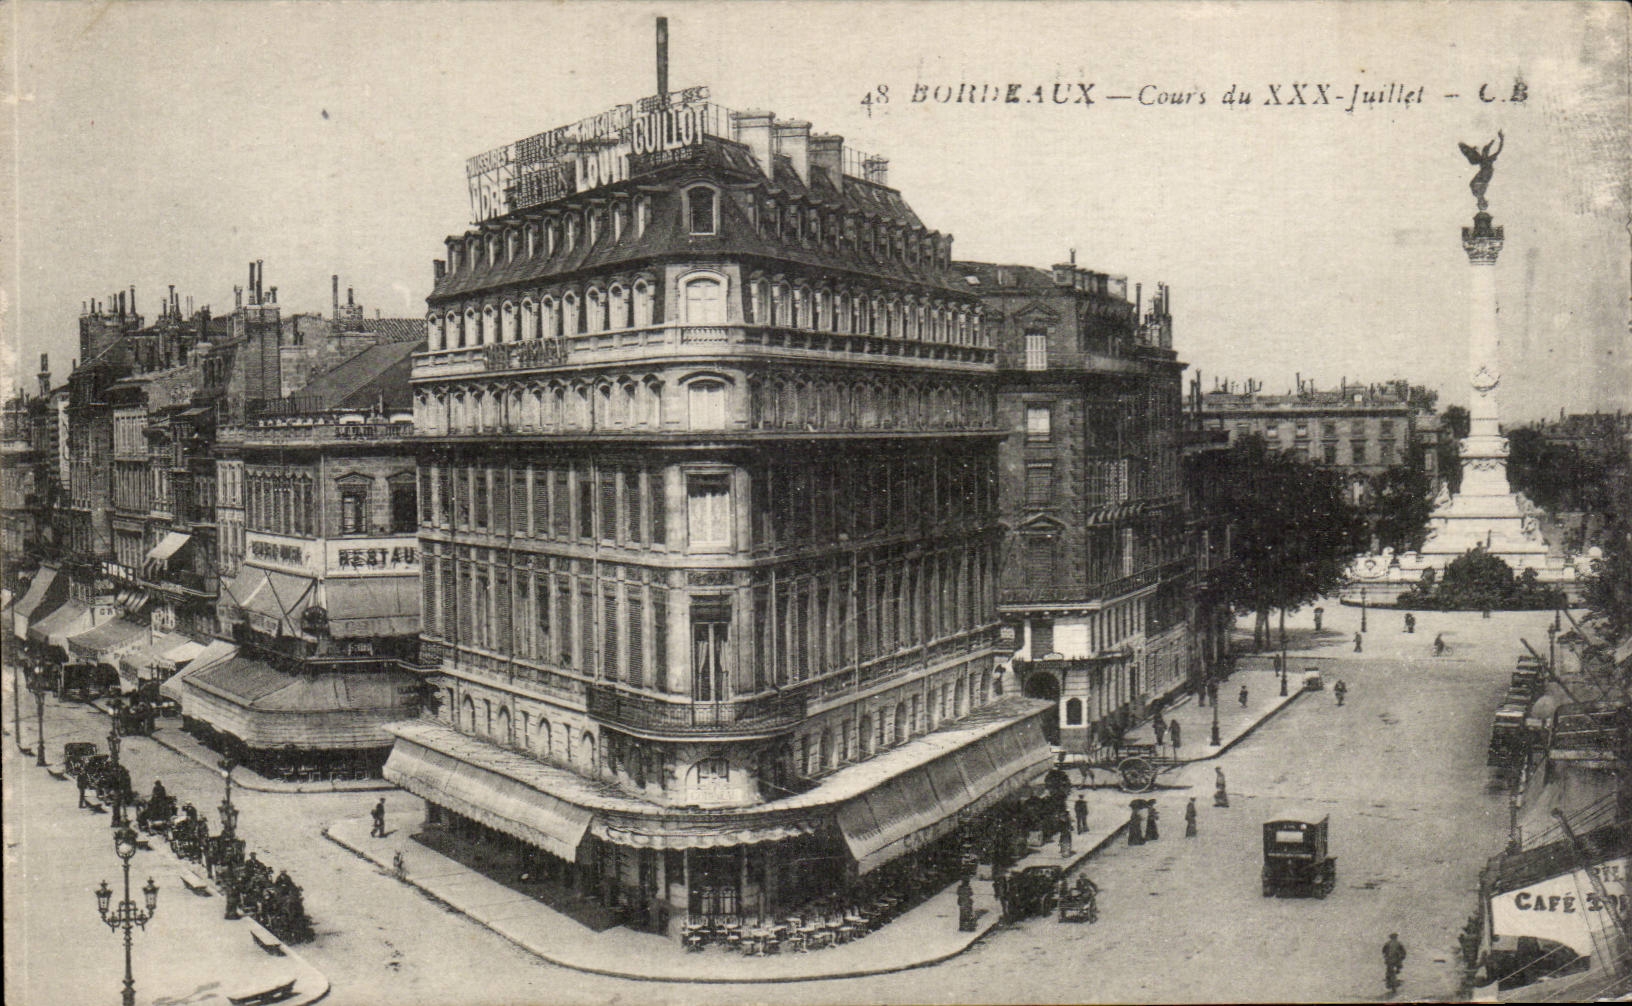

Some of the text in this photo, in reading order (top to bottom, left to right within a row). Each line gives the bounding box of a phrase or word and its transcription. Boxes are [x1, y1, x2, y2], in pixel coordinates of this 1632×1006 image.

[633, 103, 707, 156] GUILLOT
[576, 145, 632, 194] LOUIT
[338, 547, 416, 568] RESTAU
